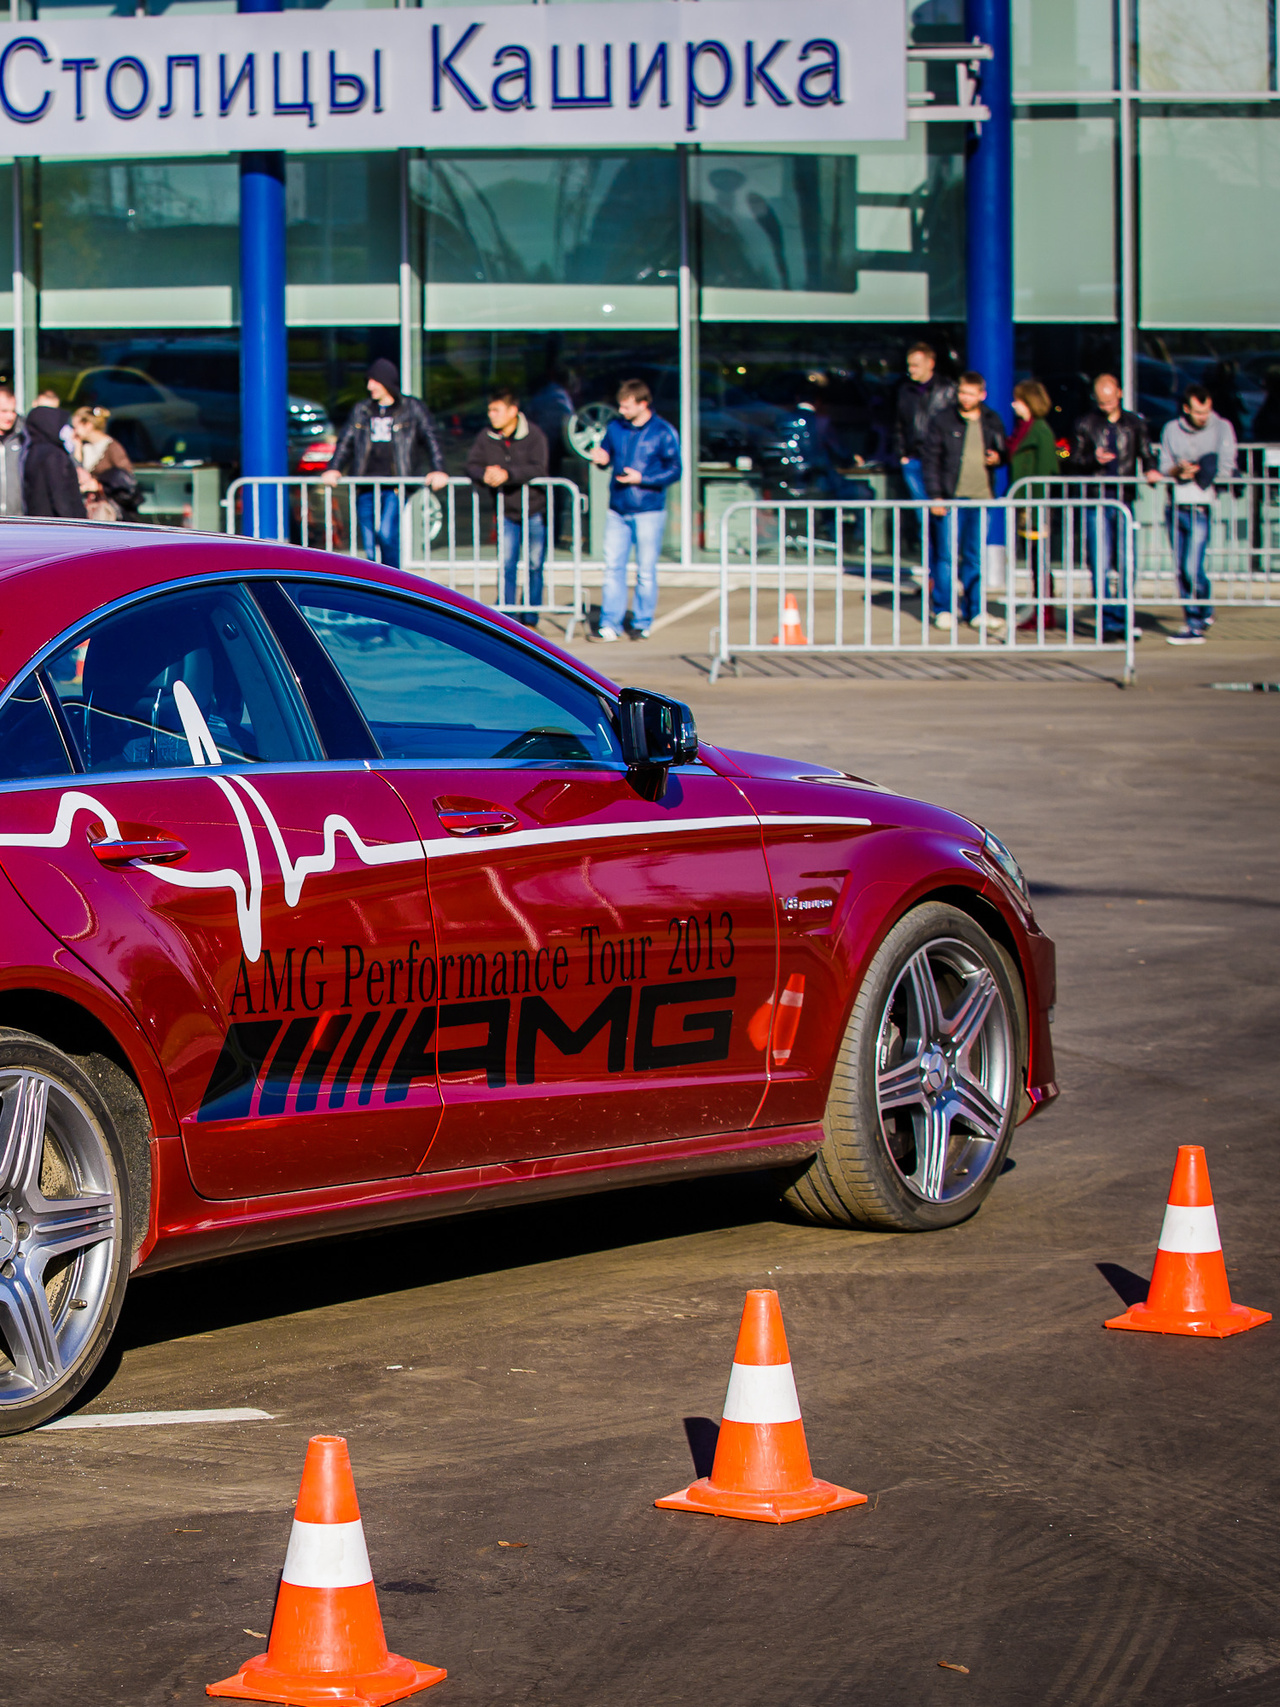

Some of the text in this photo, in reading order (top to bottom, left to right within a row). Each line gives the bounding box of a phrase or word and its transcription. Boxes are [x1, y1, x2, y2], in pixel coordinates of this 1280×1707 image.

[431, 22, 842, 127] Каширка
[228, 911, 735, 1016] AMG Performance Tour 2013
[384, 977, 736, 1104] AMG
